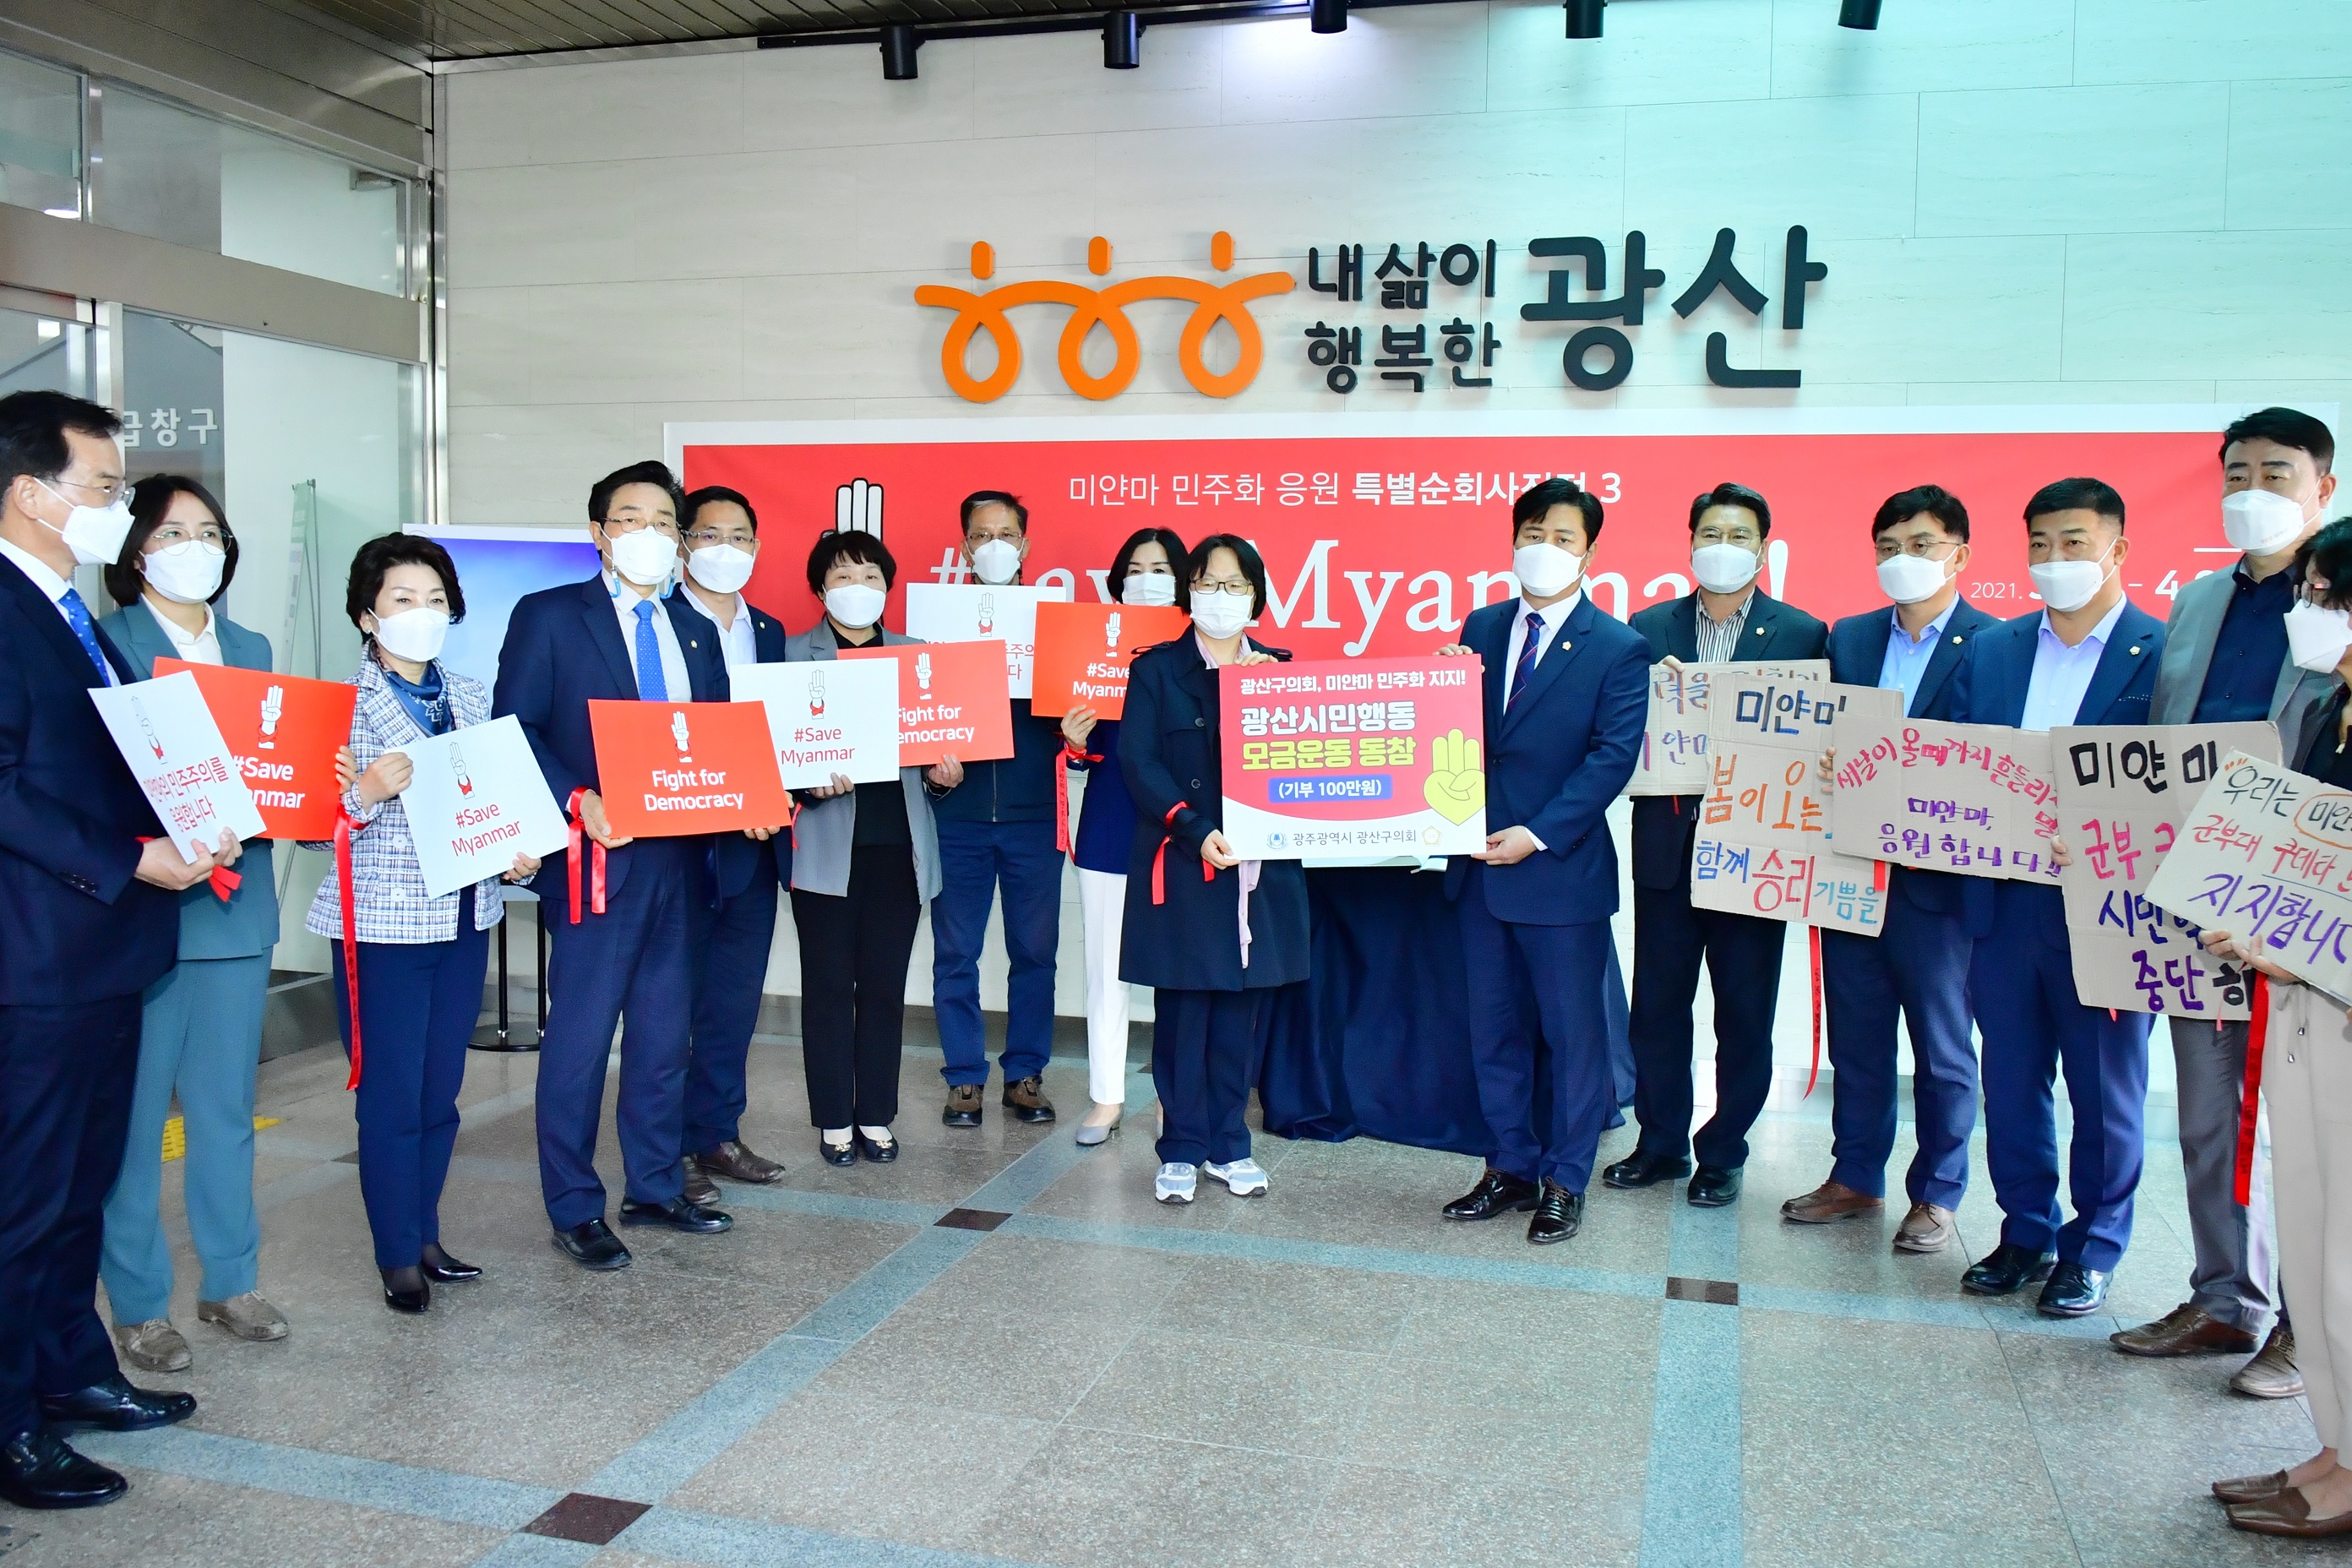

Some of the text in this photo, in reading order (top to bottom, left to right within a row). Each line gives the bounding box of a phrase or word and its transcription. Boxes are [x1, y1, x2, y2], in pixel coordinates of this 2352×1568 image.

[1520, 224, 1828, 391] 광산
[1304, 317, 1502, 395] 행복한
[1070, 471, 1621, 506] 미얀마 민주화 응원 특별순회사 3
[1970, 581, 2023, 600] 2021.
[1072, 681, 1128, 700] Myanm
[1239, 669, 1466, 695] 광산구의회, 미얀마 민주화 지지!
[936, 704, 962, 721] for
[1240, 700, 1417, 737] 광산시민행동
[793, 727, 842, 743] #Save
[899, 727, 975, 744] emocracy
[780, 745, 856, 767] Myanmar
[1241, 735, 1418, 770] 모금운동 동참
[651, 768, 727, 790] Fight for
[1278, 779, 1382, 799] (기부 100만원)
[1705, 754, 1768, 825] 봄이
[1989, 754, 2058, 808] 흔들리
[644, 791, 744, 812] Democracy
[455, 803, 501, 830] #Save
[451, 820, 521, 857] Myanmar
[1293, 831, 1353, 847] 광주광역시
[1356, 830, 1417, 845] 광산구의회
[2081, 818, 2142, 880] 군부
[1696, 840, 1880, 925] 함께 승리 기쁨을
